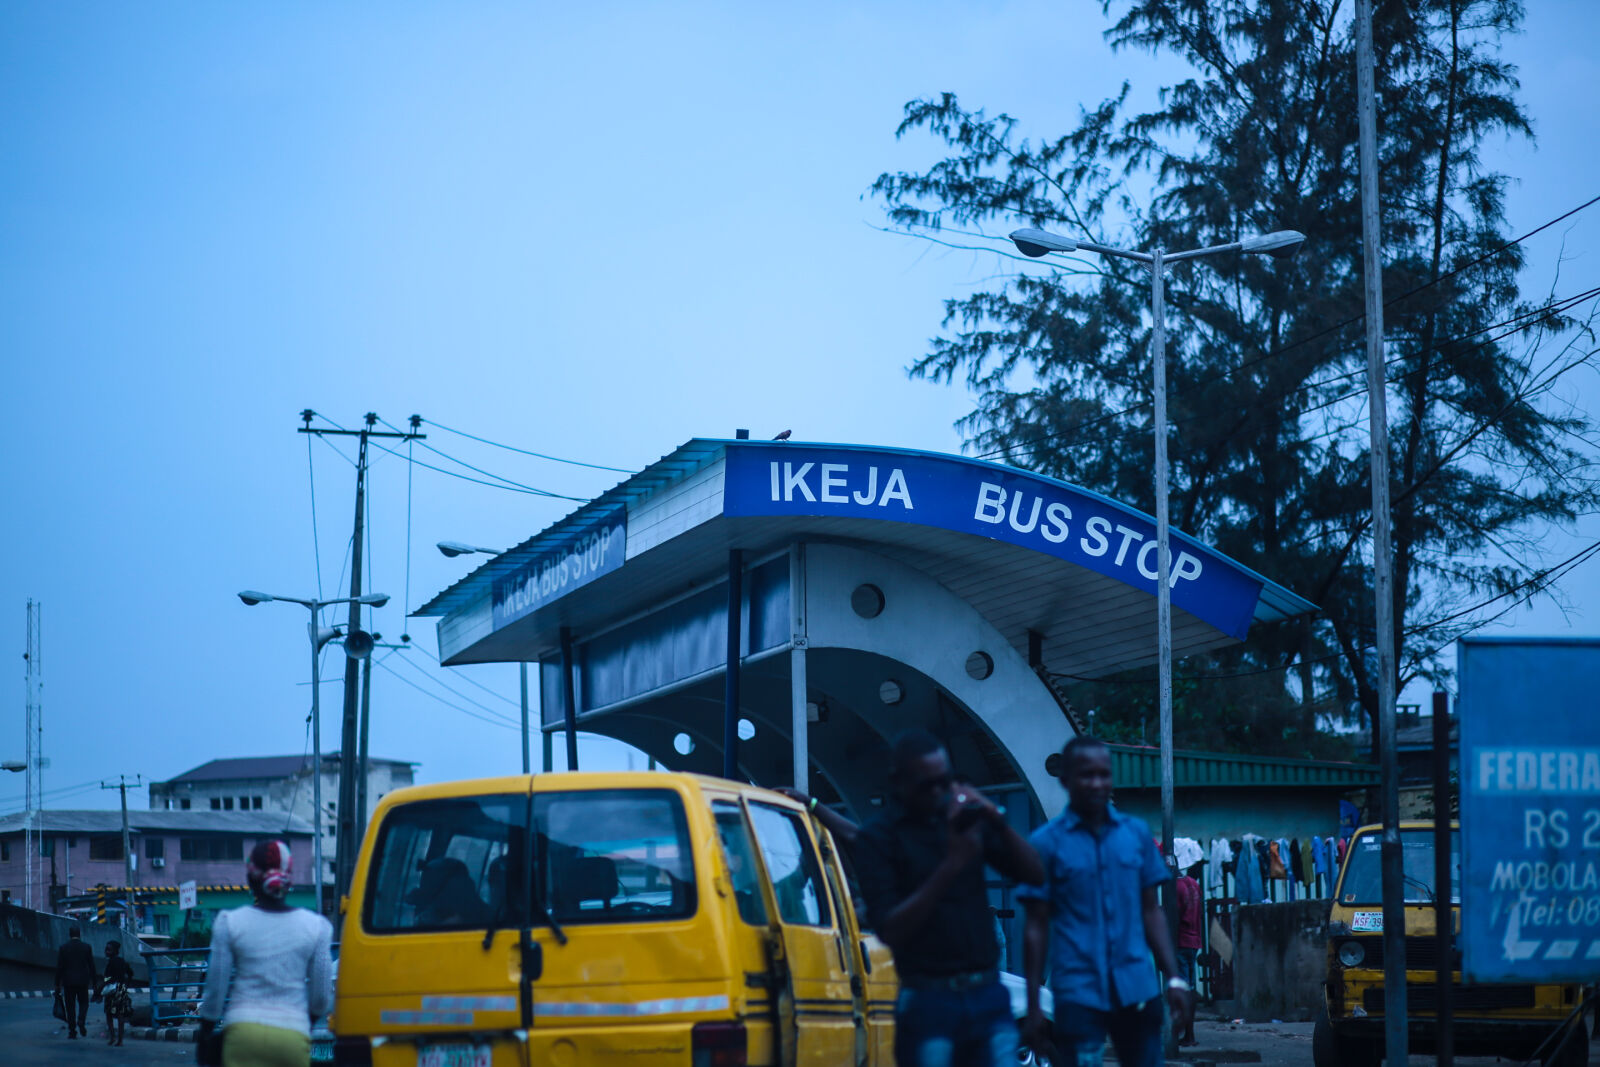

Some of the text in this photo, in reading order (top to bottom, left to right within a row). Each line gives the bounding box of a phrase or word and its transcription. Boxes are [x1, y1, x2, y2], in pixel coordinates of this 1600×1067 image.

[770, 461, 1203, 589] IKEJA BUS STOP
[503, 525, 611, 618] IKEJA BUS STOP
[1480, 751, 1600, 790] FEDERA
[1525, 808, 1569, 849] RS
[1490, 861, 1598, 892] MOBOLA
[1371, 917, 1385, 928] 39
